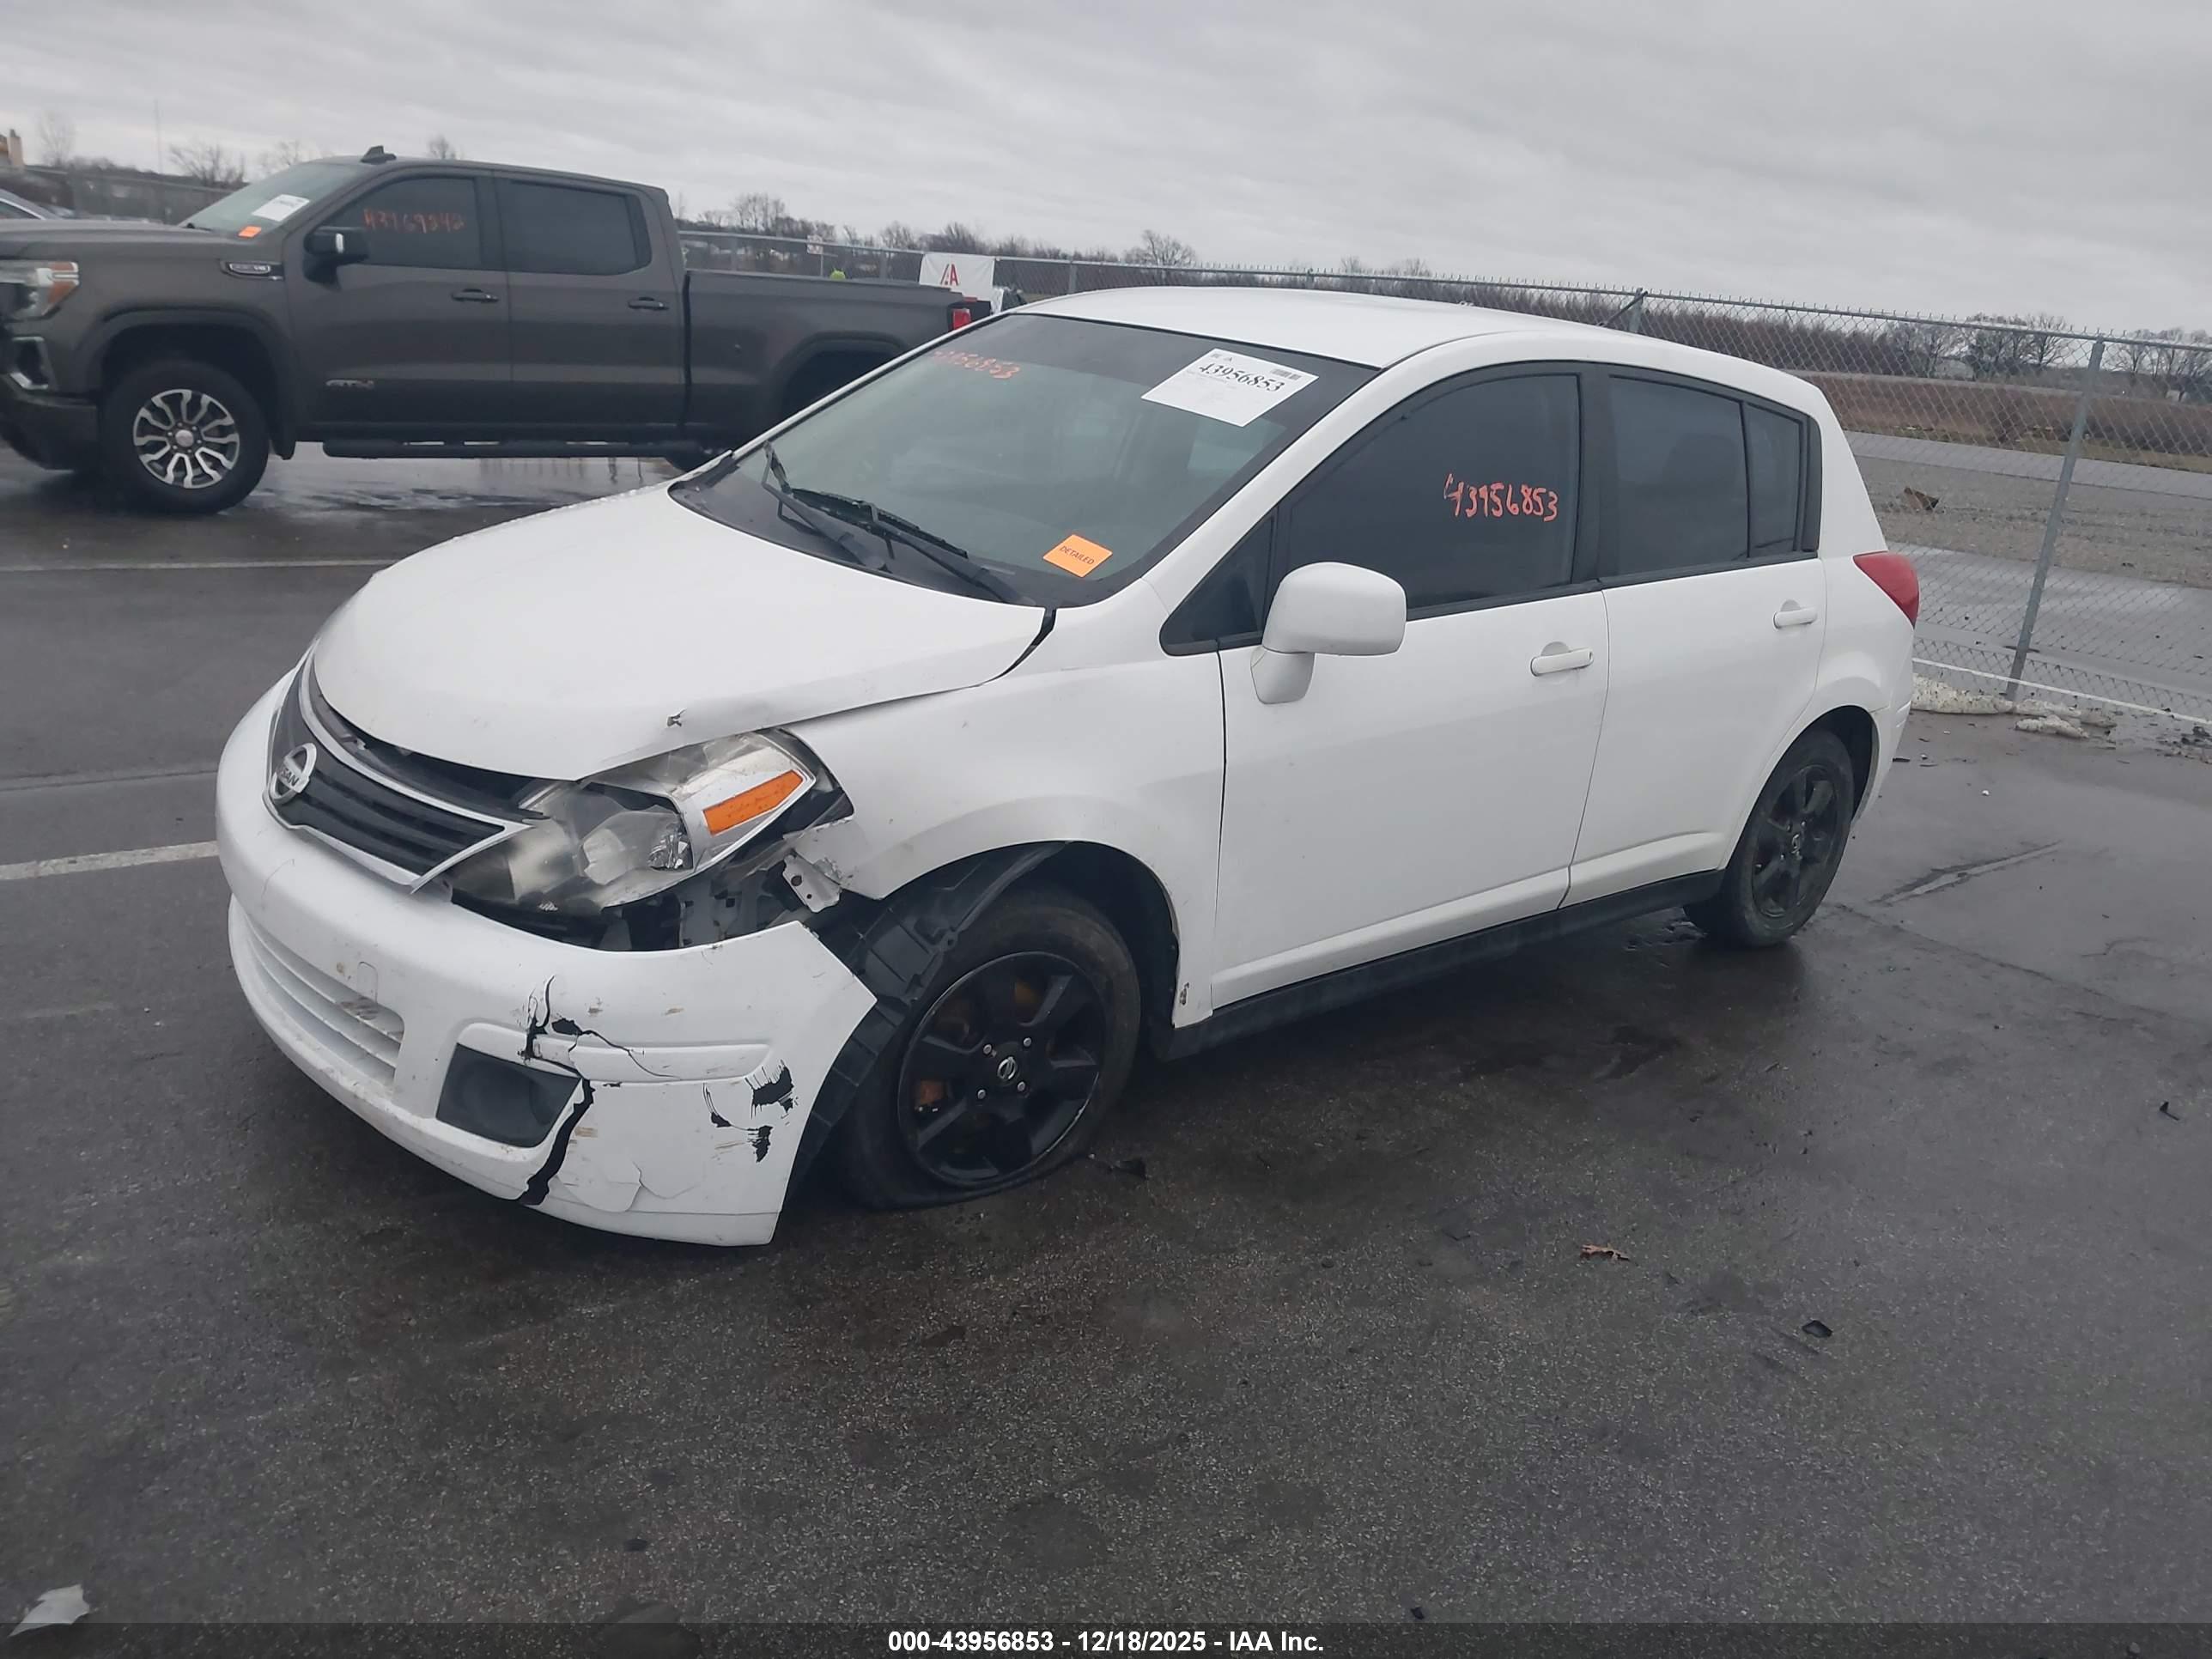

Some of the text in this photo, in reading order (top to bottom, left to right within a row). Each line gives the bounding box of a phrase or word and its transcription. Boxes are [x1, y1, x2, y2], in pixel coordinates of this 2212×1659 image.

[1199, 362, 1285, 392] 43956853
[1443, 473, 1559, 522] 43956853
[1059, 545, 1095, 565] DETAILED
